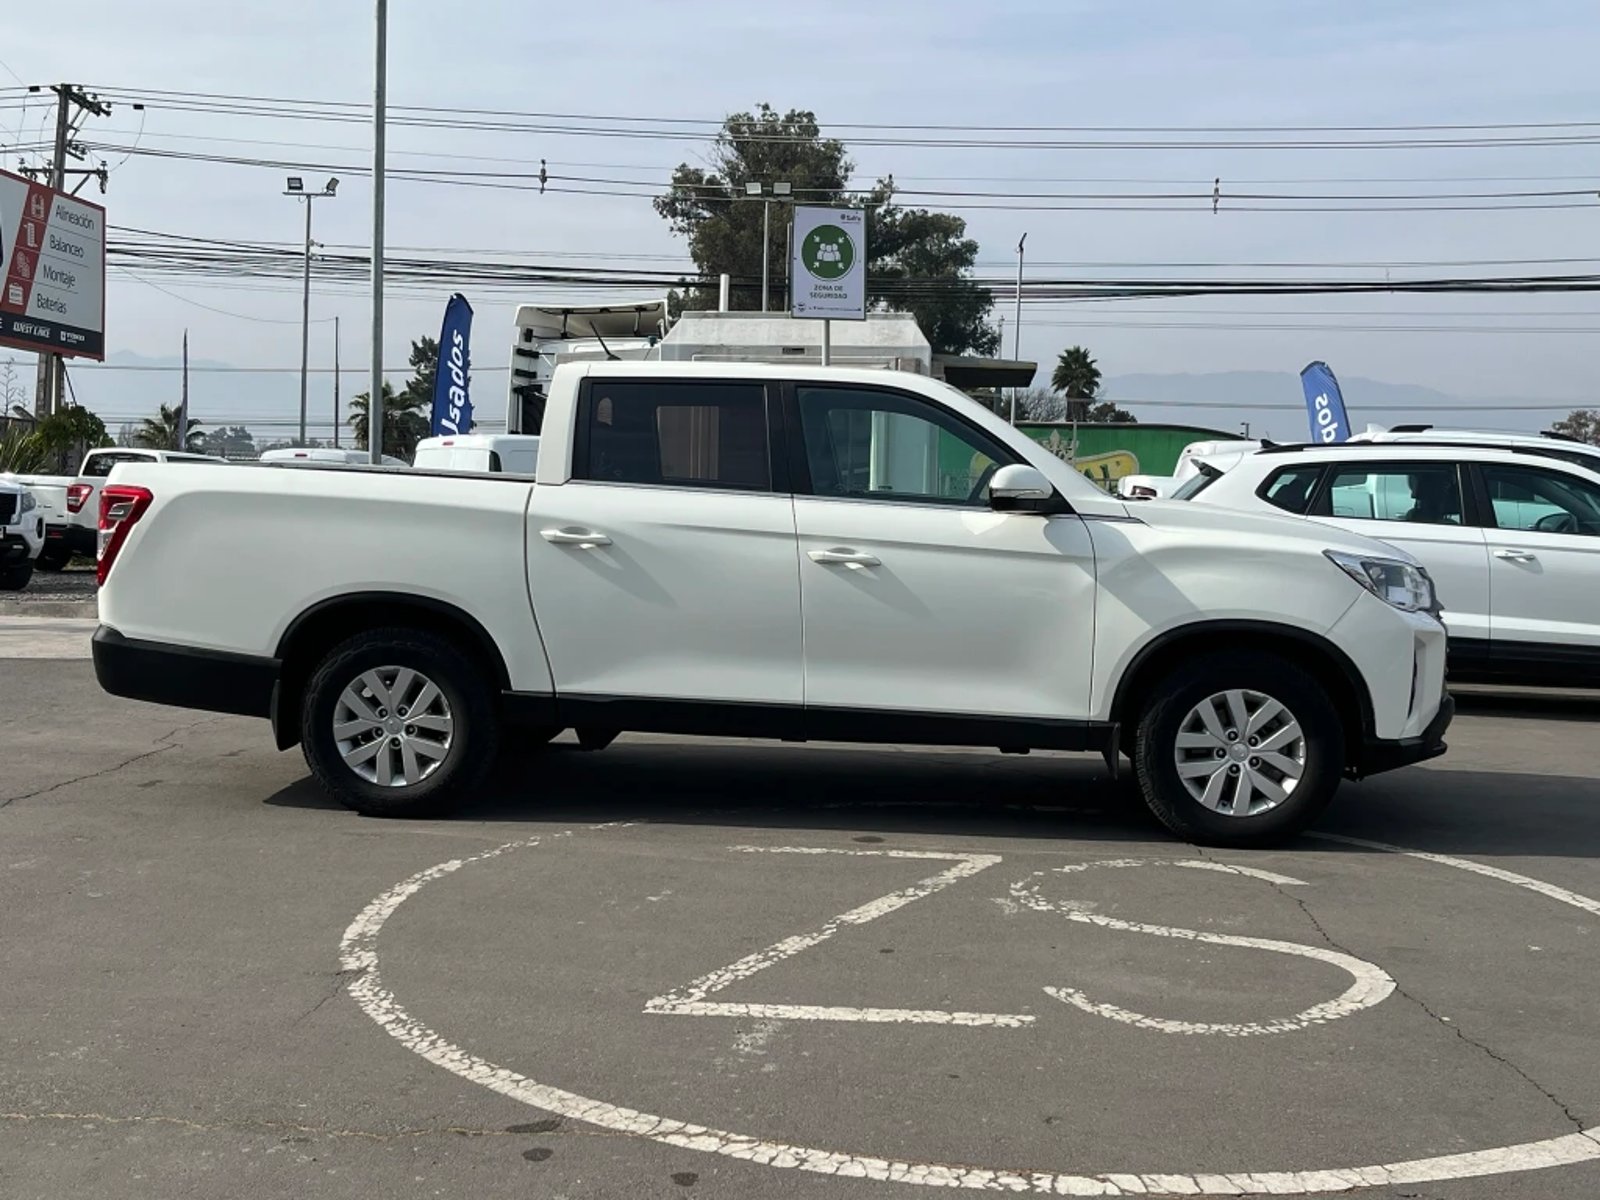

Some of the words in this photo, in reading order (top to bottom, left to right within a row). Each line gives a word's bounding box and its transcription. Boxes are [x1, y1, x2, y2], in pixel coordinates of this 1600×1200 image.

[56, 205, 94, 230] Alineación
[50, 234, 84, 258] Balanceo
[43, 264, 76, 289] Montaje
[36, 293, 67, 315] Baterías
